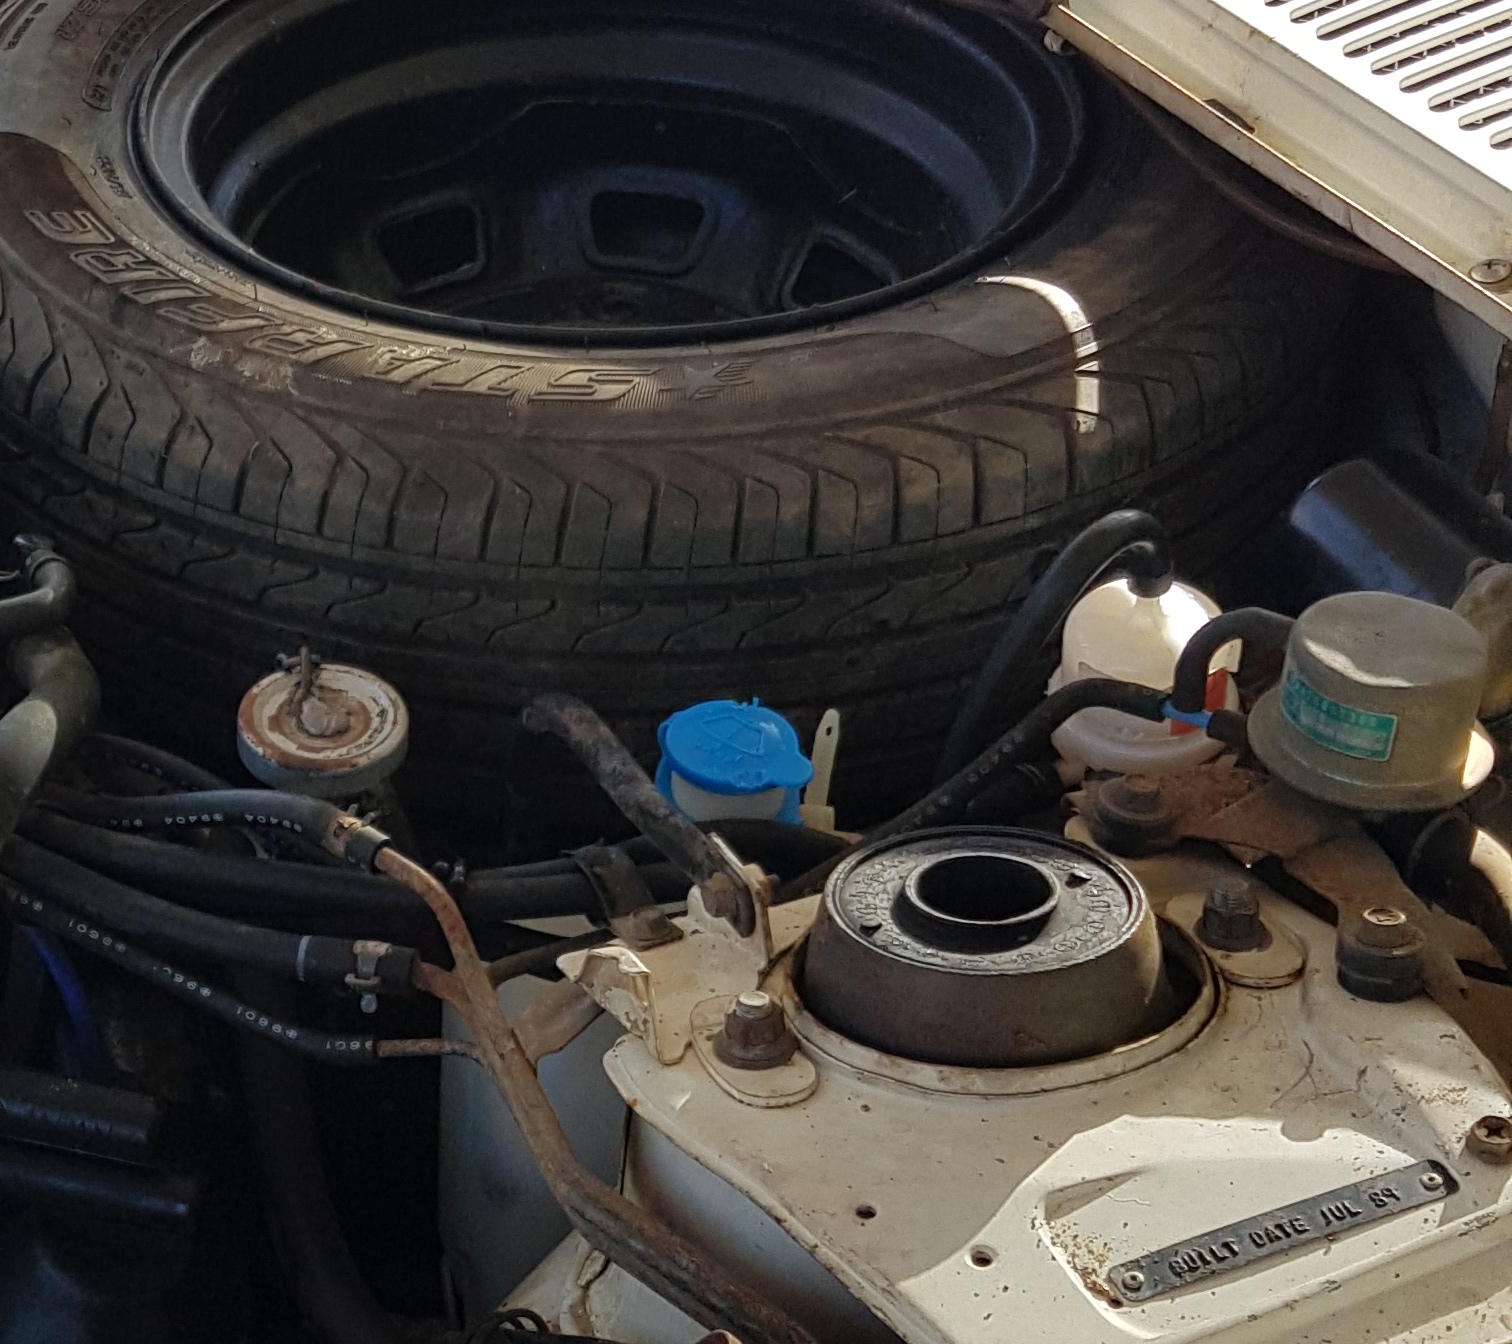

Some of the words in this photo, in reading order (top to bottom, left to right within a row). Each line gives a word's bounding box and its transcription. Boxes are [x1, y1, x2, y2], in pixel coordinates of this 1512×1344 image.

[23, 206, 656, 404] STARFIRE
[1167, 1236, 1241, 1279] BUILT
[1251, 1214, 1312, 1250] DATE
[1318, 1199, 1364, 1230] JUL
[1368, 1185, 1402, 1210] 89
